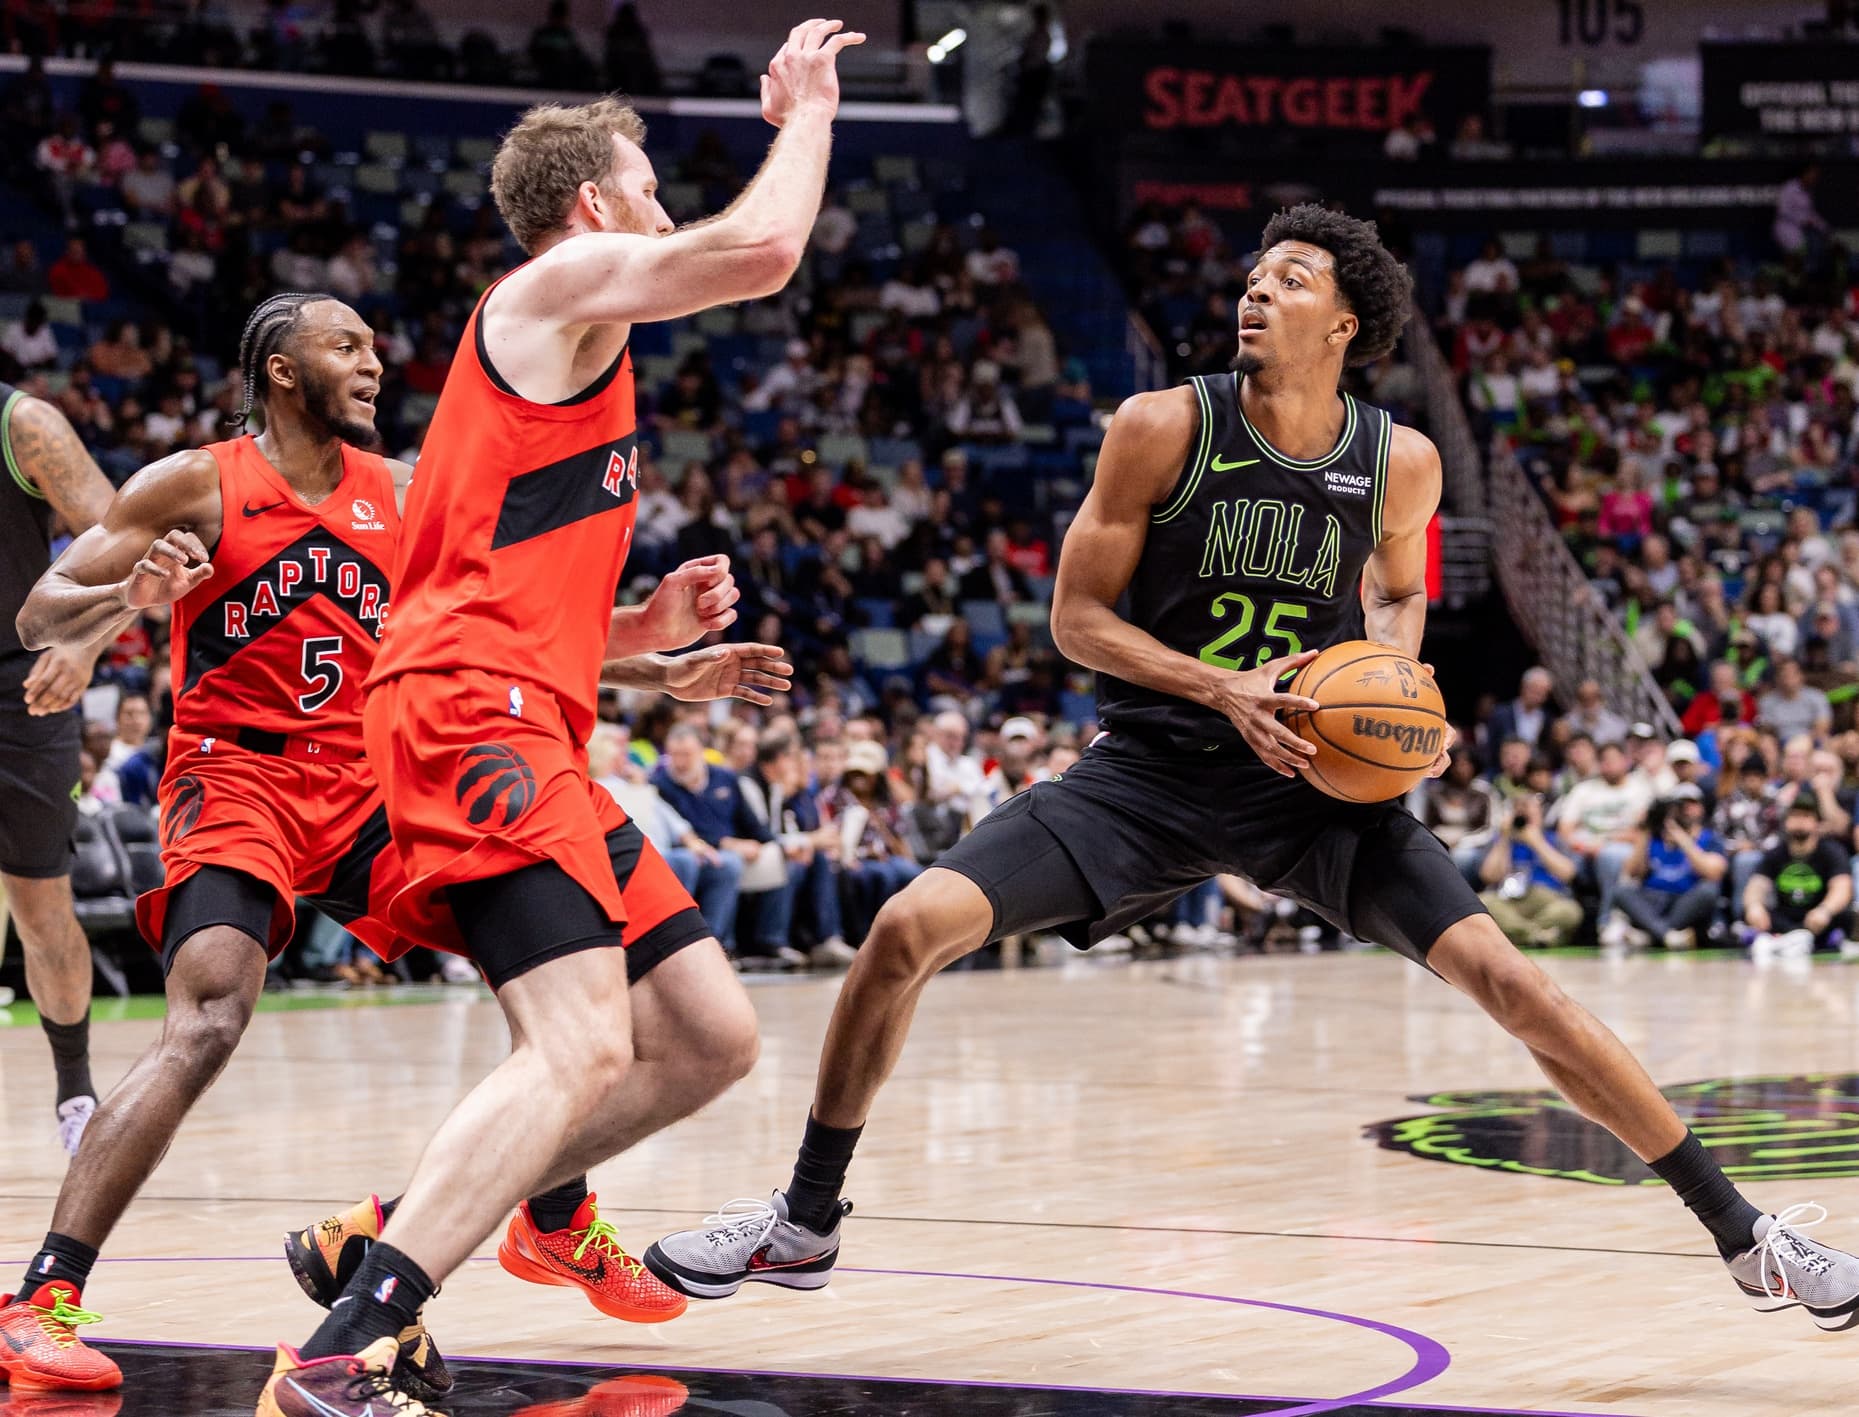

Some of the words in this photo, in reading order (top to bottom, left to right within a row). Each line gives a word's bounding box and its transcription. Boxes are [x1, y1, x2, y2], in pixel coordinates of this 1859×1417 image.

[1144, 67, 1432, 130] SEATGEEK
[1325, 471, 1371, 487] NEWAGE
[1328, 484, 1365, 495] PRODUCTS
[352, 521, 369, 530] Sun
[367, 521, 385, 530] Life
[1199, 499, 1340, 597] NOLA
[1199, 591, 1308, 681] 25
[299, 635, 343, 712] 5
[1352, 714, 1441, 755] Wilson
